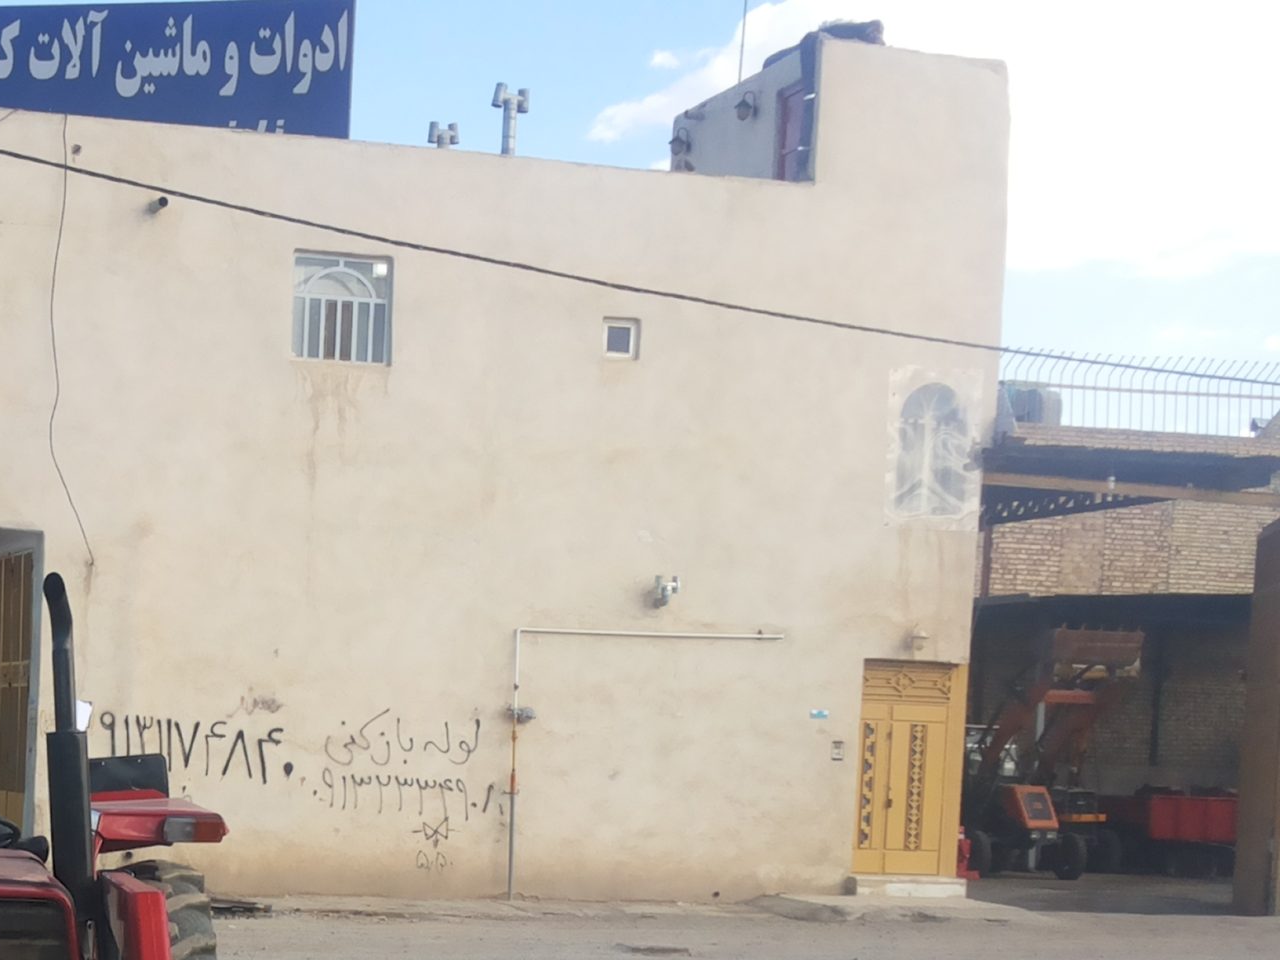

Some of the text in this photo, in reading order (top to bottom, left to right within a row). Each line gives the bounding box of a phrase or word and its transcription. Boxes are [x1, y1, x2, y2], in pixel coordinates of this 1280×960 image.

[28, 9, 109, 81] آلات
[114, 14, 212, 99] ماشین
[219, 40, 239, 97] و
[249, 10, 349, 95] ادوات
